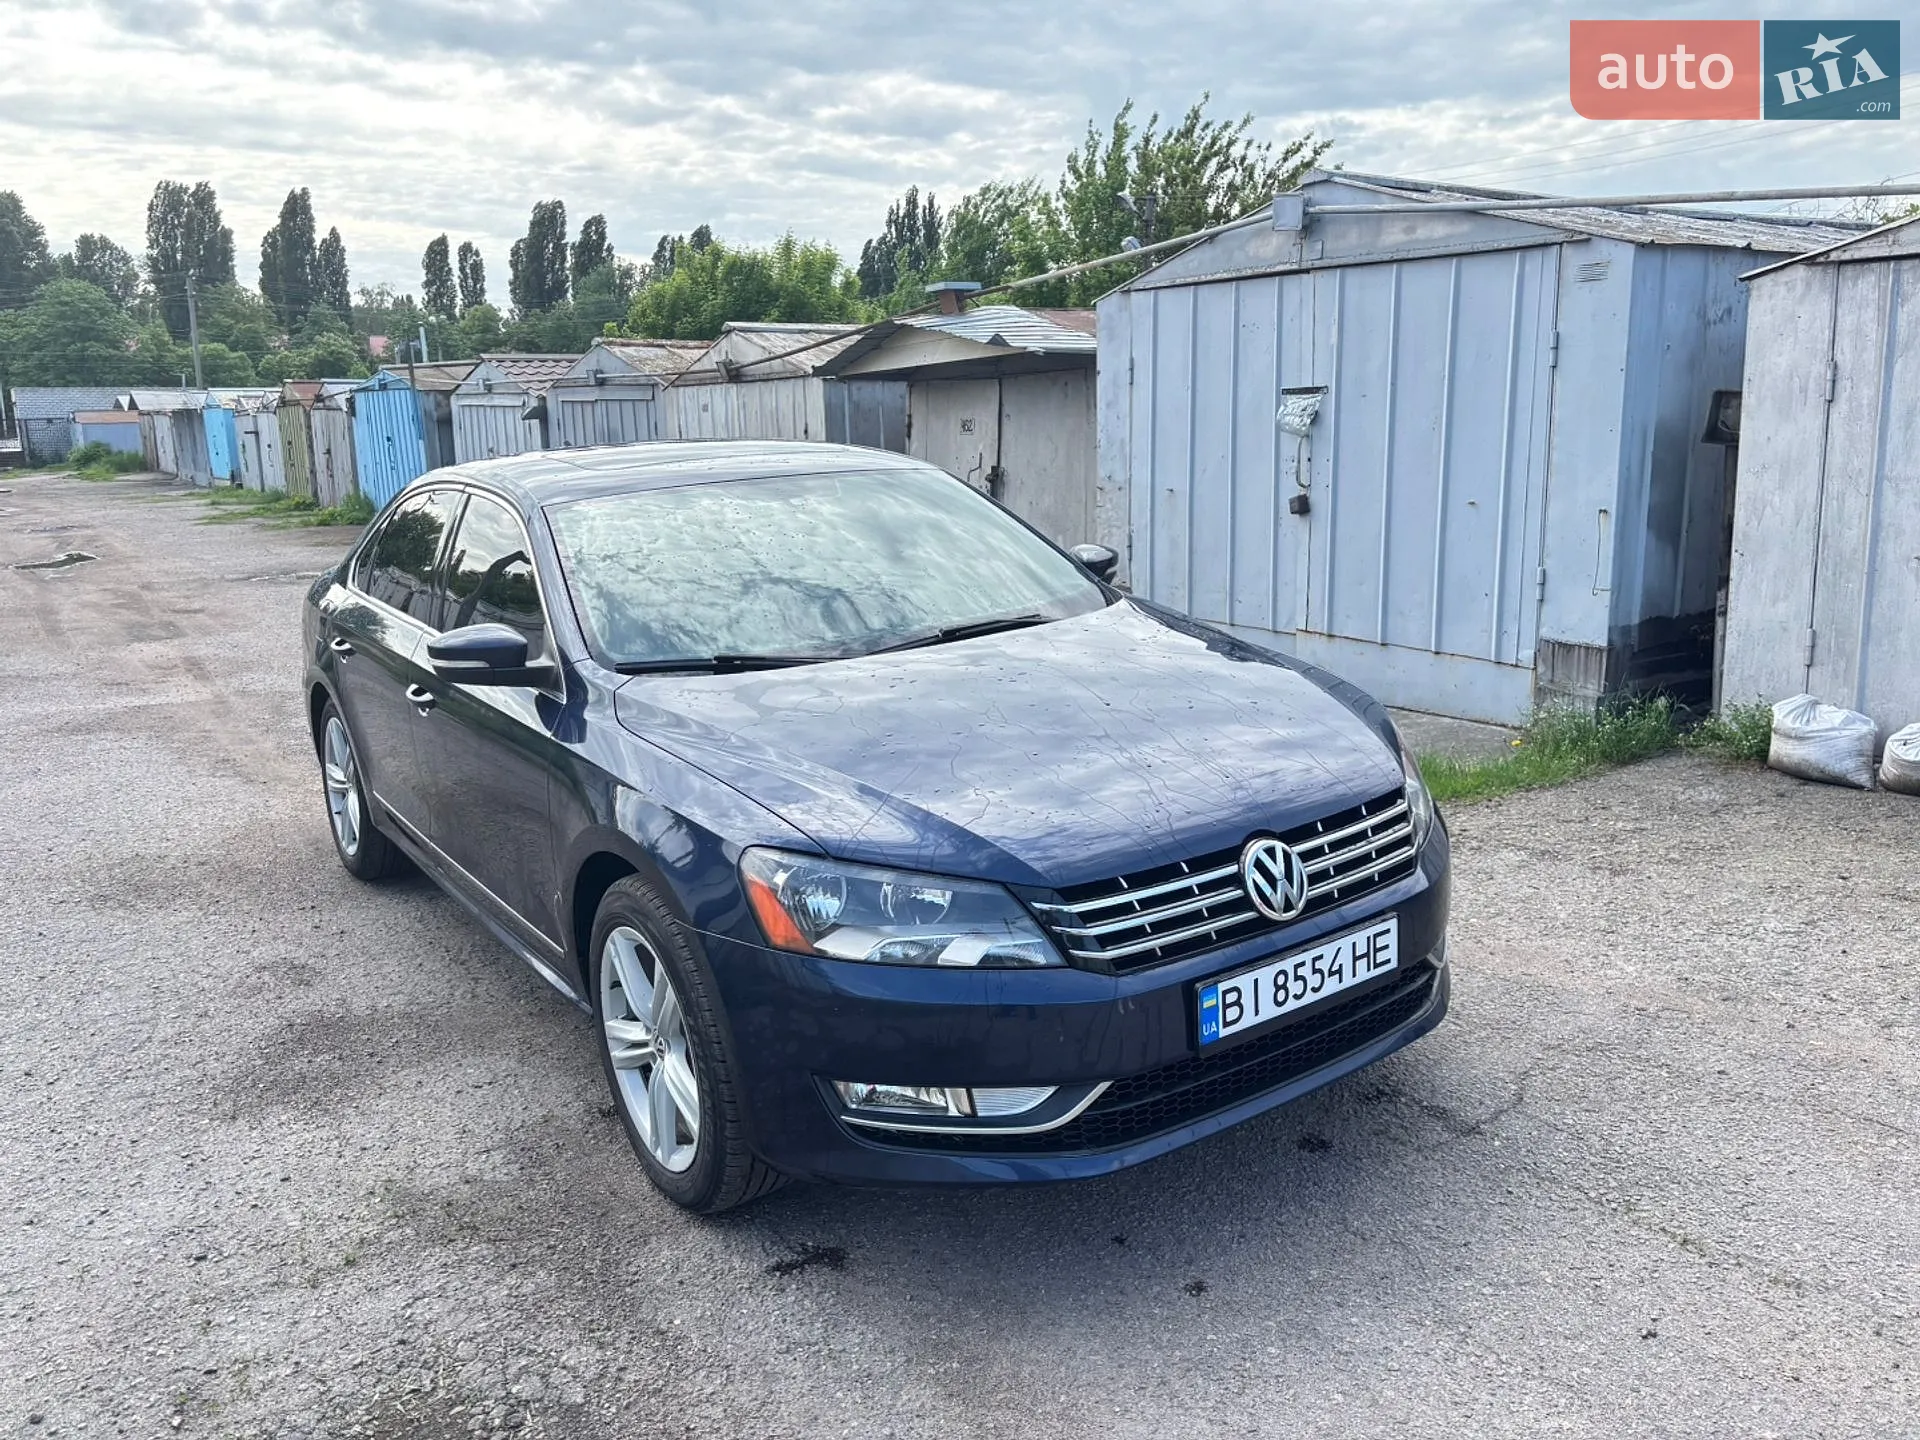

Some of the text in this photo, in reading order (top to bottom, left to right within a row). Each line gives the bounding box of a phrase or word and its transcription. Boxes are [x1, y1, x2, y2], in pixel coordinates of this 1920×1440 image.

[1221, 928, 1392, 1029] BI 8554 HE
[1202, 1020, 1218, 1036] UA
